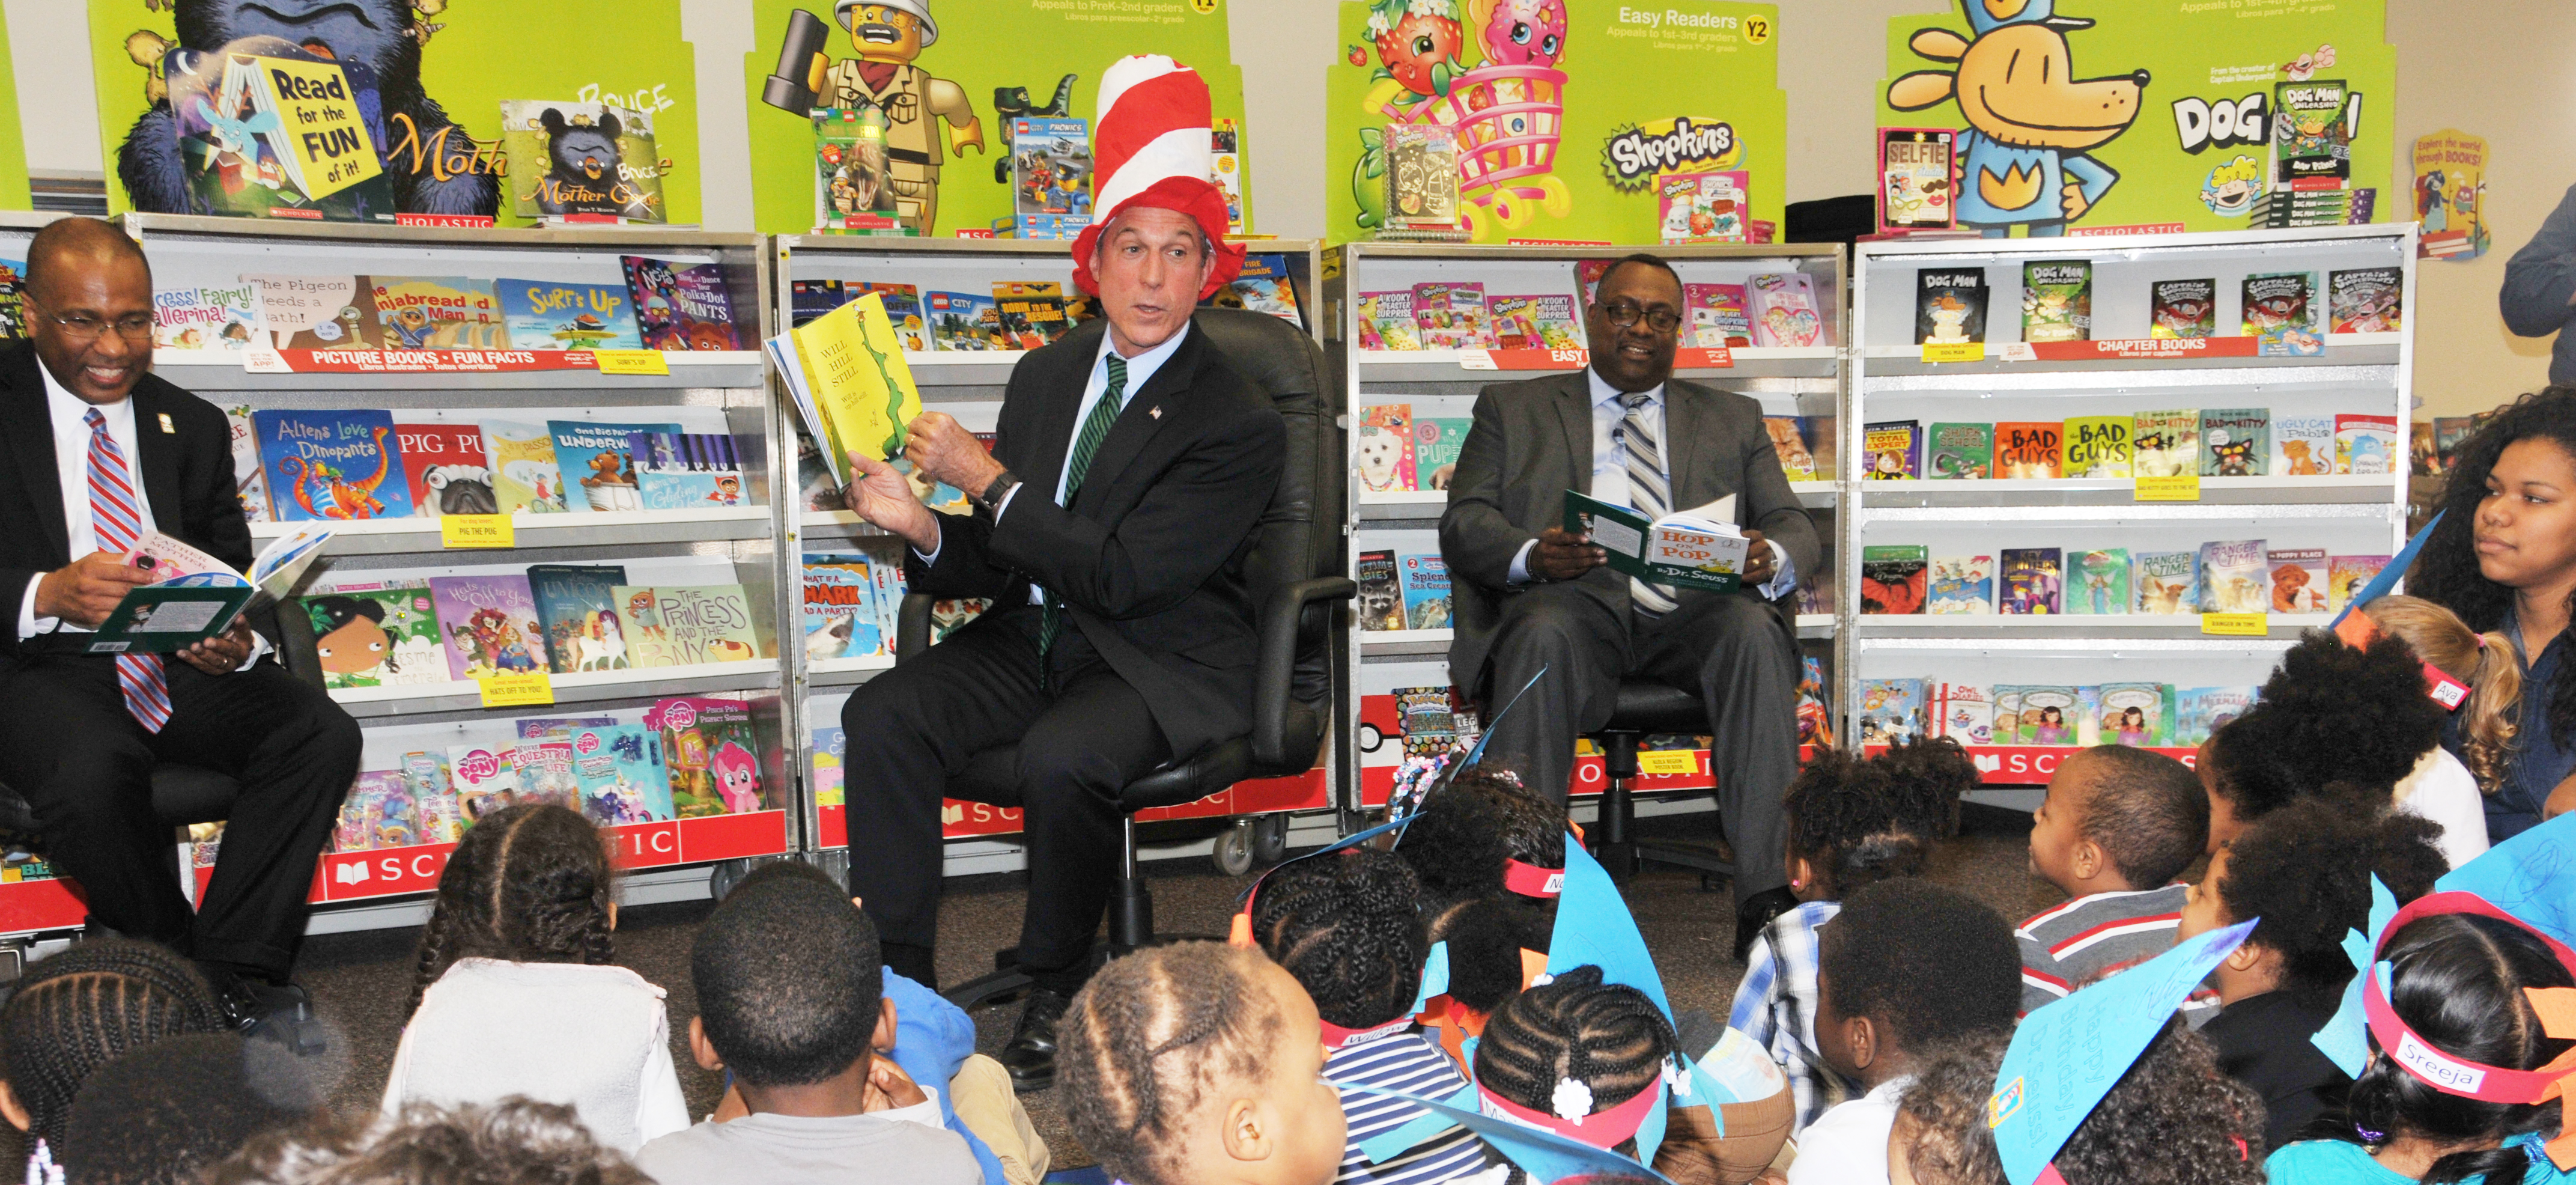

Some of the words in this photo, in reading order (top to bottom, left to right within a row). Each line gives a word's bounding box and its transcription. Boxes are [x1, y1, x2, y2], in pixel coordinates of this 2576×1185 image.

[1077, 1, 1088, 10] to
[1143, 3, 1184, 14] graders
[1620, 7, 1661, 28] Easy
[1666, 10, 1737, 29] Readers
[1606, 26, 1647, 37] Appeals
[1648, 28, 1659, 37] to
[1699, 32, 1737, 43] graders
[1747, 21, 1767, 37] Y2
[2211, 67, 2228, 76] From
[2241, 65, 2267, 73] creator
[2268, 63, 2275, 72] of
[270, 69, 345, 102] Read
[2210, 74, 2234, 84] Captain
[2286, 88, 2312, 104] DOG
[2315, 88, 2340, 102] MAN
[2293, 102, 2338, 110] UNLEASHED
[297, 108, 319, 124] for
[323, 105, 347, 121] the
[2174, 94, 2264, 150] DOG
[303, 127, 362, 162] FUN
[1612, 121, 1730, 174] Shopkins
[2418, 139, 2443, 151] Explore
[2445, 137, 2456, 148] the
[1889, 144, 1945, 163] SELFIE
[2446, 151, 2482, 167] BOOKS!
[327, 165, 342, 184] of
[344, 160, 360, 178] it!
[521, 175, 605, 206] Mother
[610, 182, 660, 206] Goose
[278, 210, 322, 219] SCHOLASTIC
[2084, 224, 2184, 237] SCHOLASTIC
[678, 273, 693, 283] Sing
[1239, 267, 1272, 277] BRIGADE
[2032, 267, 2057, 279] DOG
[2059, 266, 2085, 279] MAN
[288, 280, 348, 294] Pigeon
[1925, 274, 1950, 288] DOG
[1952, 274, 1978, 288] MAN
[201, 285, 254, 309] Fairy!
[313, 298, 323, 308] a
[952, 299, 972, 309] CITY
[1385, 293, 1411, 303] KOOKY
[1544, 297, 1569, 305] KOOKY
[428, 307, 465, 321] Man
[680, 301, 729, 321] PANTS
[886, 302, 914, 311] OFF!
[1001, 302, 1031, 314] ROBIN
[1376, 309, 1412, 319] SURPRISE
[1546, 305, 1570, 313] EASTER
[1026, 311, 1064, 322] RESCUE!
[1536, 311, 1571, 320] SURPRISE
[821, 340, 848, 359] WILL
[2097, 340, 2158, 352] CHAPTER
[2163, 338, 2206, 350] BOOKS
[312, 350, 380, 365] PICTURE
[384, 352, 439, 364] BOOKS
[452, 352, 484, 364] FUN
[488, 351, 535, 364] FACTS
[829, 353, 853, 372] HILL
[1552, 350, 1582, 362] EASY
[831, 366, 859, 388] STILL
[279, 419, 331, 440] Aliens
[337, 421, 369, 440] Love
[2137, 418, 2157, 428] BAD
[2167, 417, 2197, 428] KITTY
[2205, 418, 2224, 428] BAD
[2236, 417, 2267, 428] KITTY
[2276, 419, 2306, 429] UGLY
[2310, 419, 2334, 428] CAT
[2012, 430, 2057, 448] BAD
[2080, 423, 2126, 443] BAD
[297, 440, 377, 462] Dinopants
[397, 434, 446, 453] PIG
[1867, 441, 1909, 450] EXPERT
[2000, 449, 2058, 468] GUYS
[2069, 443, 2127, 463] GUYS
[484, 527, 497, 535] PUG
[1660, 531, 1715, 547] HOP
[151, 541, 207, 570] MOTHER
[154, 535, 207, 562] FATHER
[1660, 547, 1711, 561] POP
[2211, 541, 2259, 560] RANGER
[2301, 550, 2323, 559] PLACE
[2143, 553, 2190, 571] RANGER
[2226, 550, 2259, 567] TIME
[1667, 567, 1689, 578] Dr.
[1691, 570, 1729, 583] Seuss
[2159, 562, 2190, 575] TIME
[834, 575, 841, 583] A
[449, 582, 478, 602] Hats
[471, 585, 497, 606] Off
[496, 587, 506, 597] to
[676, 589, 702, 600] THE
[661, 596, 747, 629] PRINCESS
[825, 606, 858, 615] PARTY?
[675, 626, 696, 640] AND
[699, 625, 727, 637] THE
[490, 687, 505, 696] HATS
[2438, 683, 2458, 701] Ava
[515, 743, 539, 754] WHERE
[458, 757, 500, 785] PONY
[1349, 1025, 1408, 1044] Willow
[2082, 998, 2106, 1085] Happy
[2055, 1004, 2080, 1121] Birthday,
[2404, 1044, 2473, 1086] Sreeja
